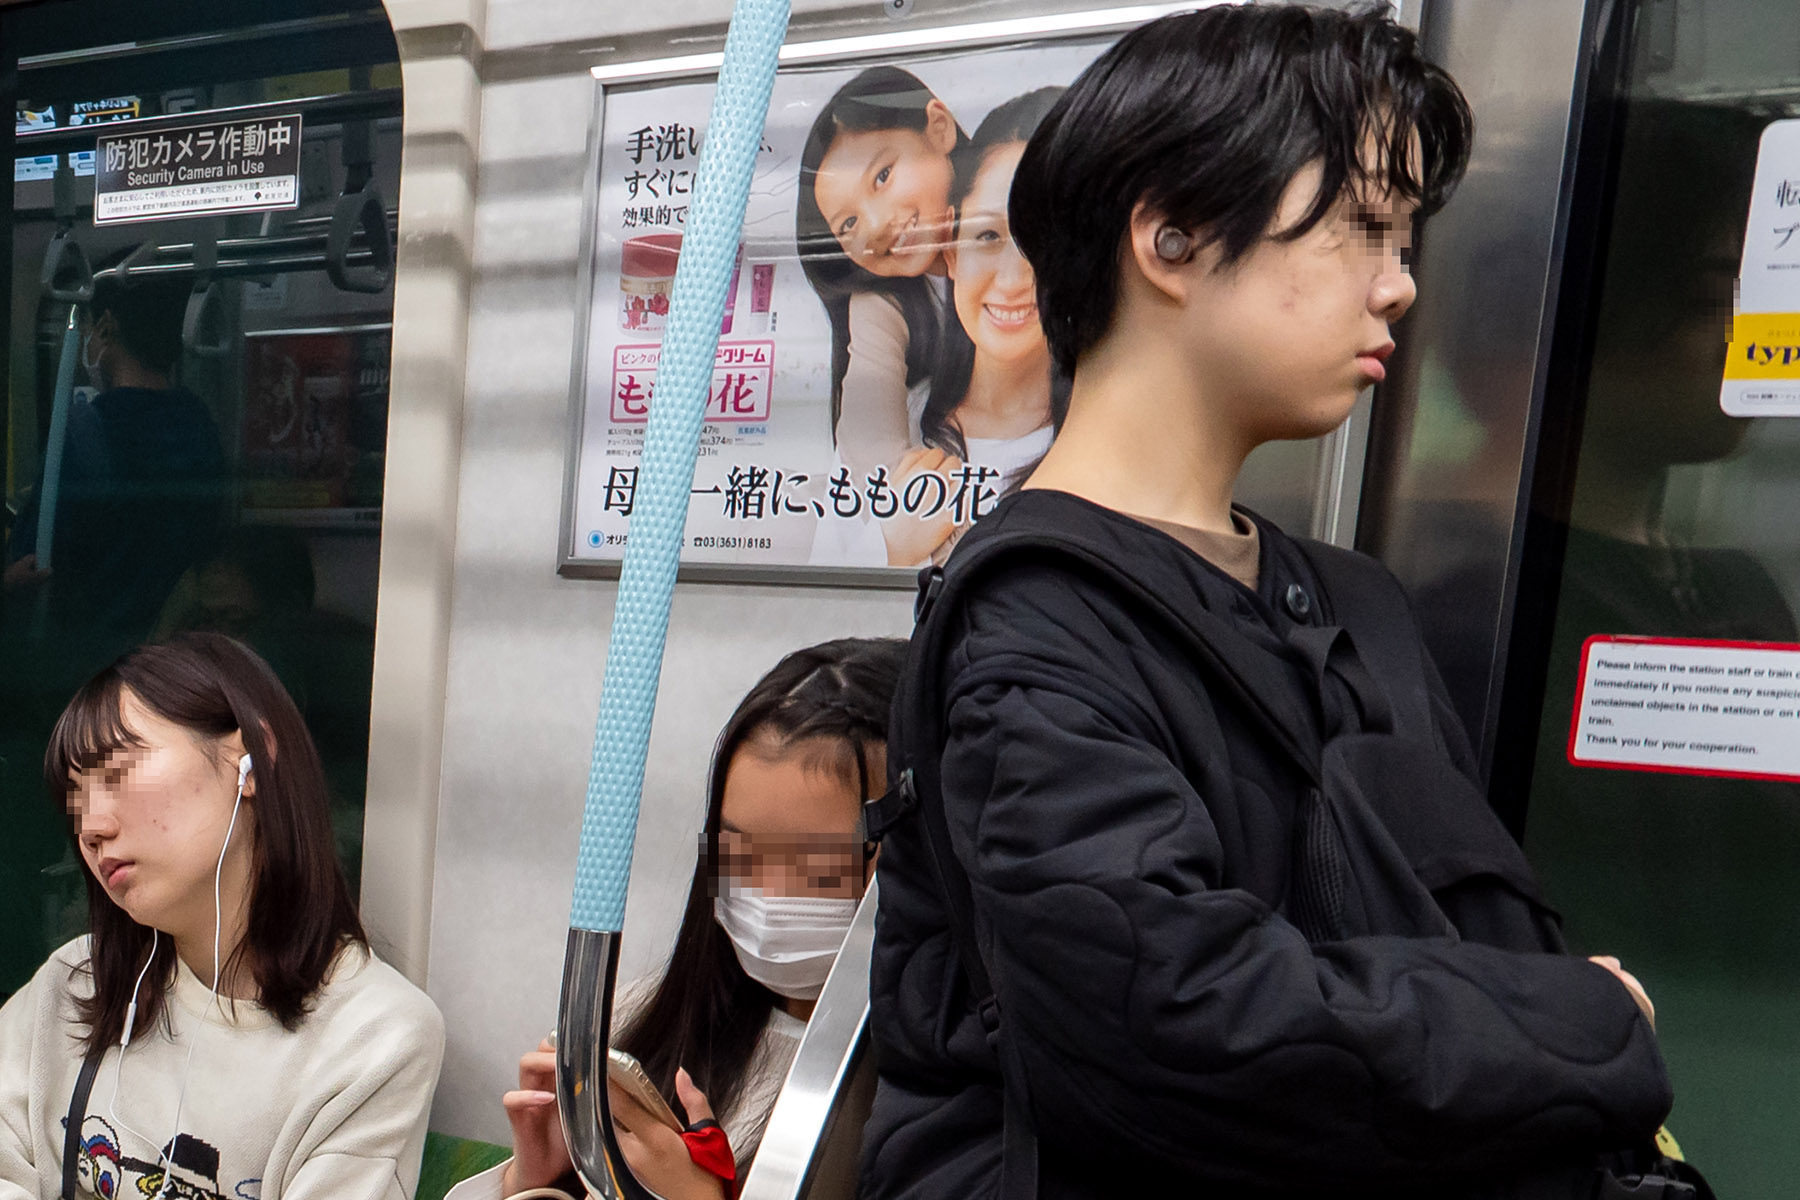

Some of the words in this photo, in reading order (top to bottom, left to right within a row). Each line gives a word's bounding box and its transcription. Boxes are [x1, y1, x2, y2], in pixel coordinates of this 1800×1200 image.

[104, 121, 292, 173] 防犯カメラ作動中
[127, 168, 176, 187] Security
[177, 165, 224, 181] Camera
[226, 161, 238, 177] in
[241, 159, 265, 175] Use
[624, 168, 696, 201] すぐに
[602, 464, 1002, 523] 母一緒に、ももの花
[1597, 659, 1631, 671] Please
[1633, 661, 1667, 673] inform
[1669, 662, 1686, 674] the
[1689, 664, 1725, 676] station
[1727, 666, 1752, 677] staff
[1754, 669, 1766, 678] or
[1768, 668, 1793, 679] train
[1593, 678, 1659, 693] immediately
[1661, 680, 1670, 691] if
[1672, 684, 1693, 695] you
[1695, 683, 1730, 695] notice
[1732, 687, 1753, 698] any
[1591, 698, 1645, 710] unclaimed
[1646, 700, 1686, 713] objects
[1688, 701, 1699, 712] in
[1702, 702, 1719, 713] the
[1722, 704, 1761, 716] station
[1763, 708, 1775, 717] or
[1778, 709, 1795, 719] on
[1588, 715, 1615, 727] train.
[1586, 733, 1618, 746] Thank
[1621, 737, 1641, 748] you
[1643, 737, 1660, 748] for
[1661, 739, 1687, 751] your
[1689, 741, 1759, 755] cooperation.
